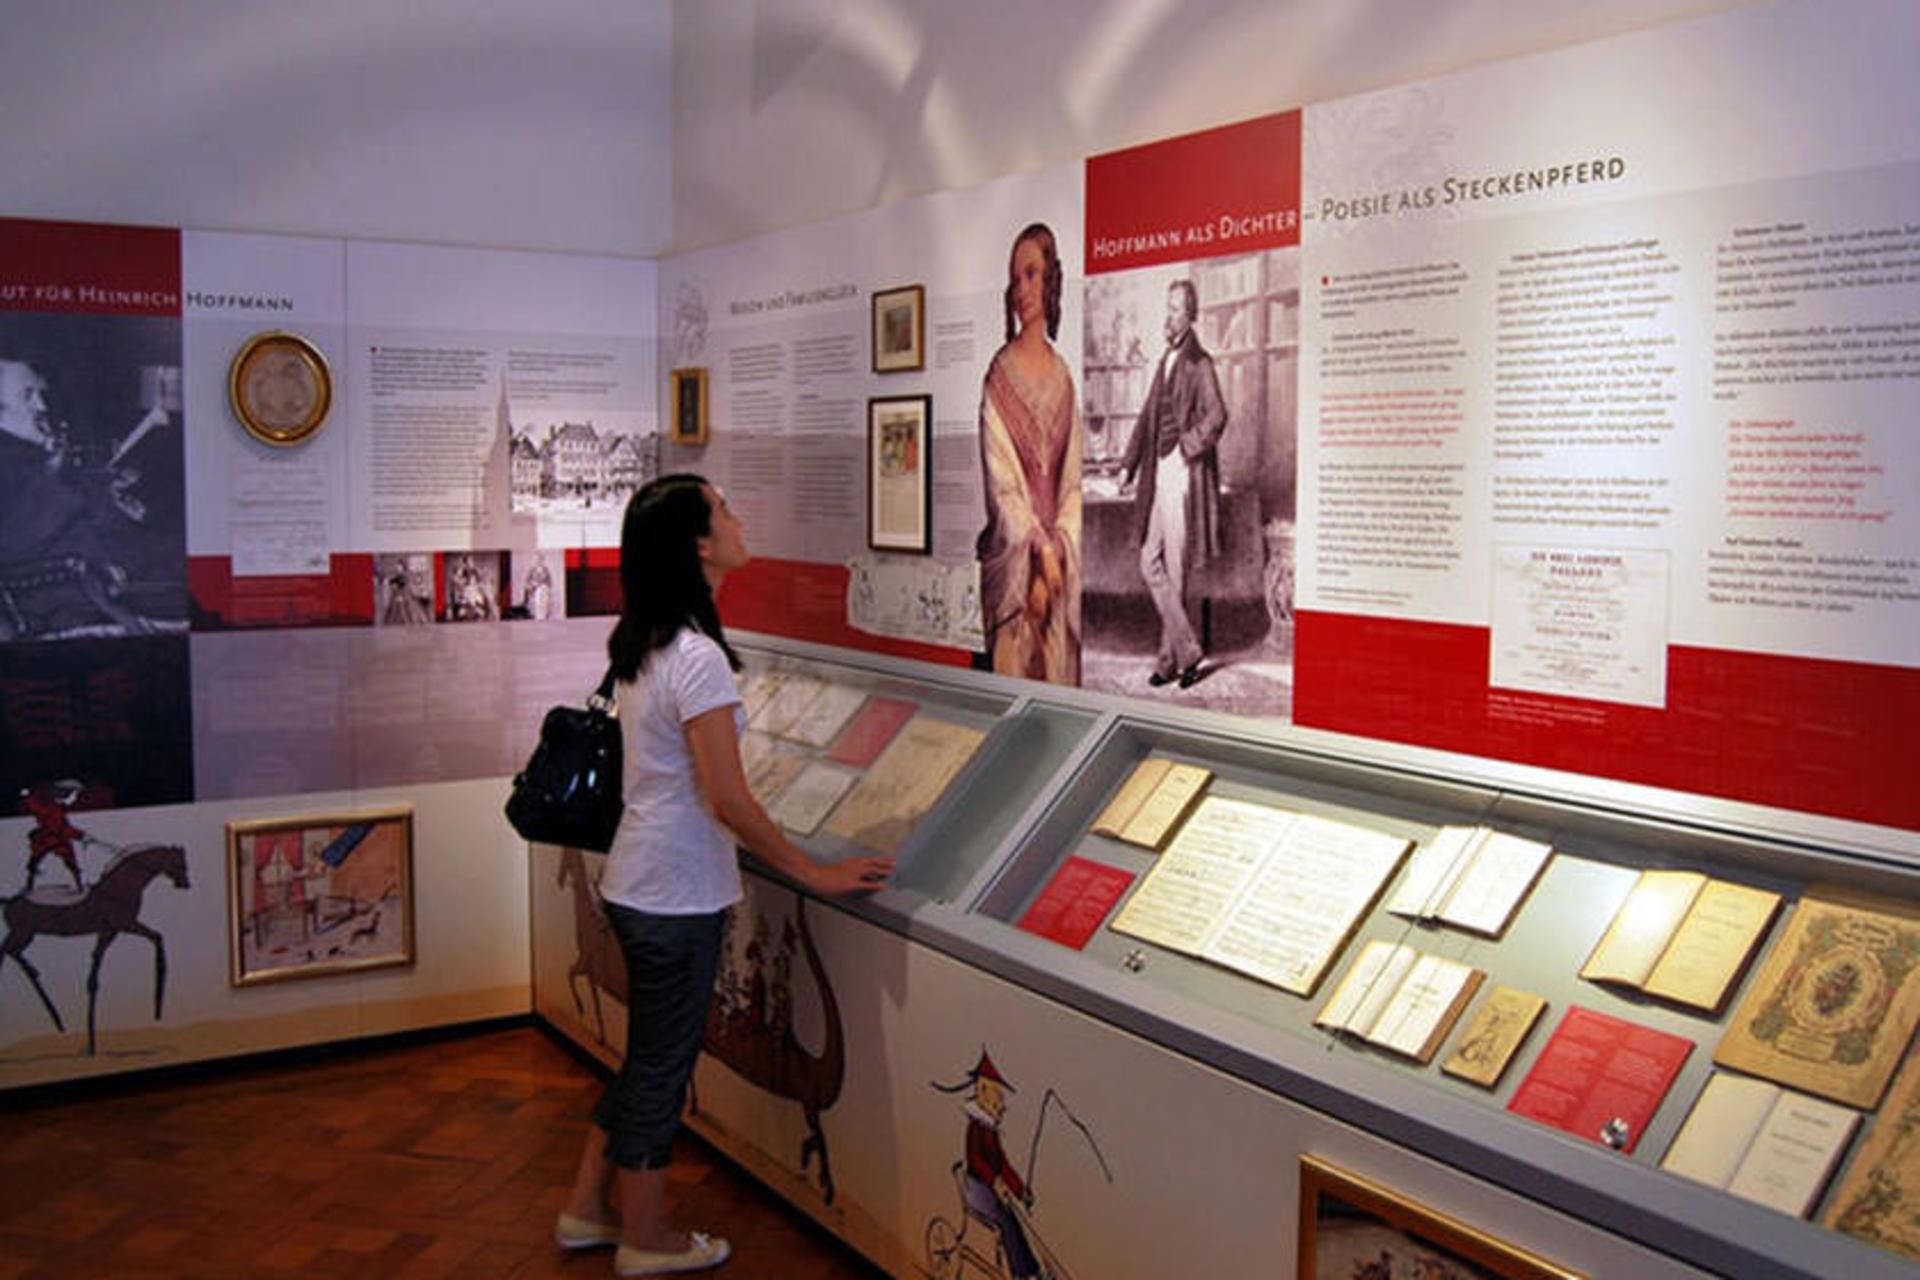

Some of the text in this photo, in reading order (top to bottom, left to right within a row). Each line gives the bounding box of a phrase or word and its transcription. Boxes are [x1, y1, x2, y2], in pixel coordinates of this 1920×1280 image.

[1093, 231, 1181, 258] HOFFMANN
[1187, 222, 1215, 243] ALS
[1220, 210, 1297, 241] DICHTER
[1321, 194, 1391, 221] POESIE
[1398, 187, 1436, 211] ALS
[1443, 157, 1625, 204] STECKENPFERD
[78, 285, 178, 308] HEINRICH
[187, 291, 294, 311] HOFFMANN
